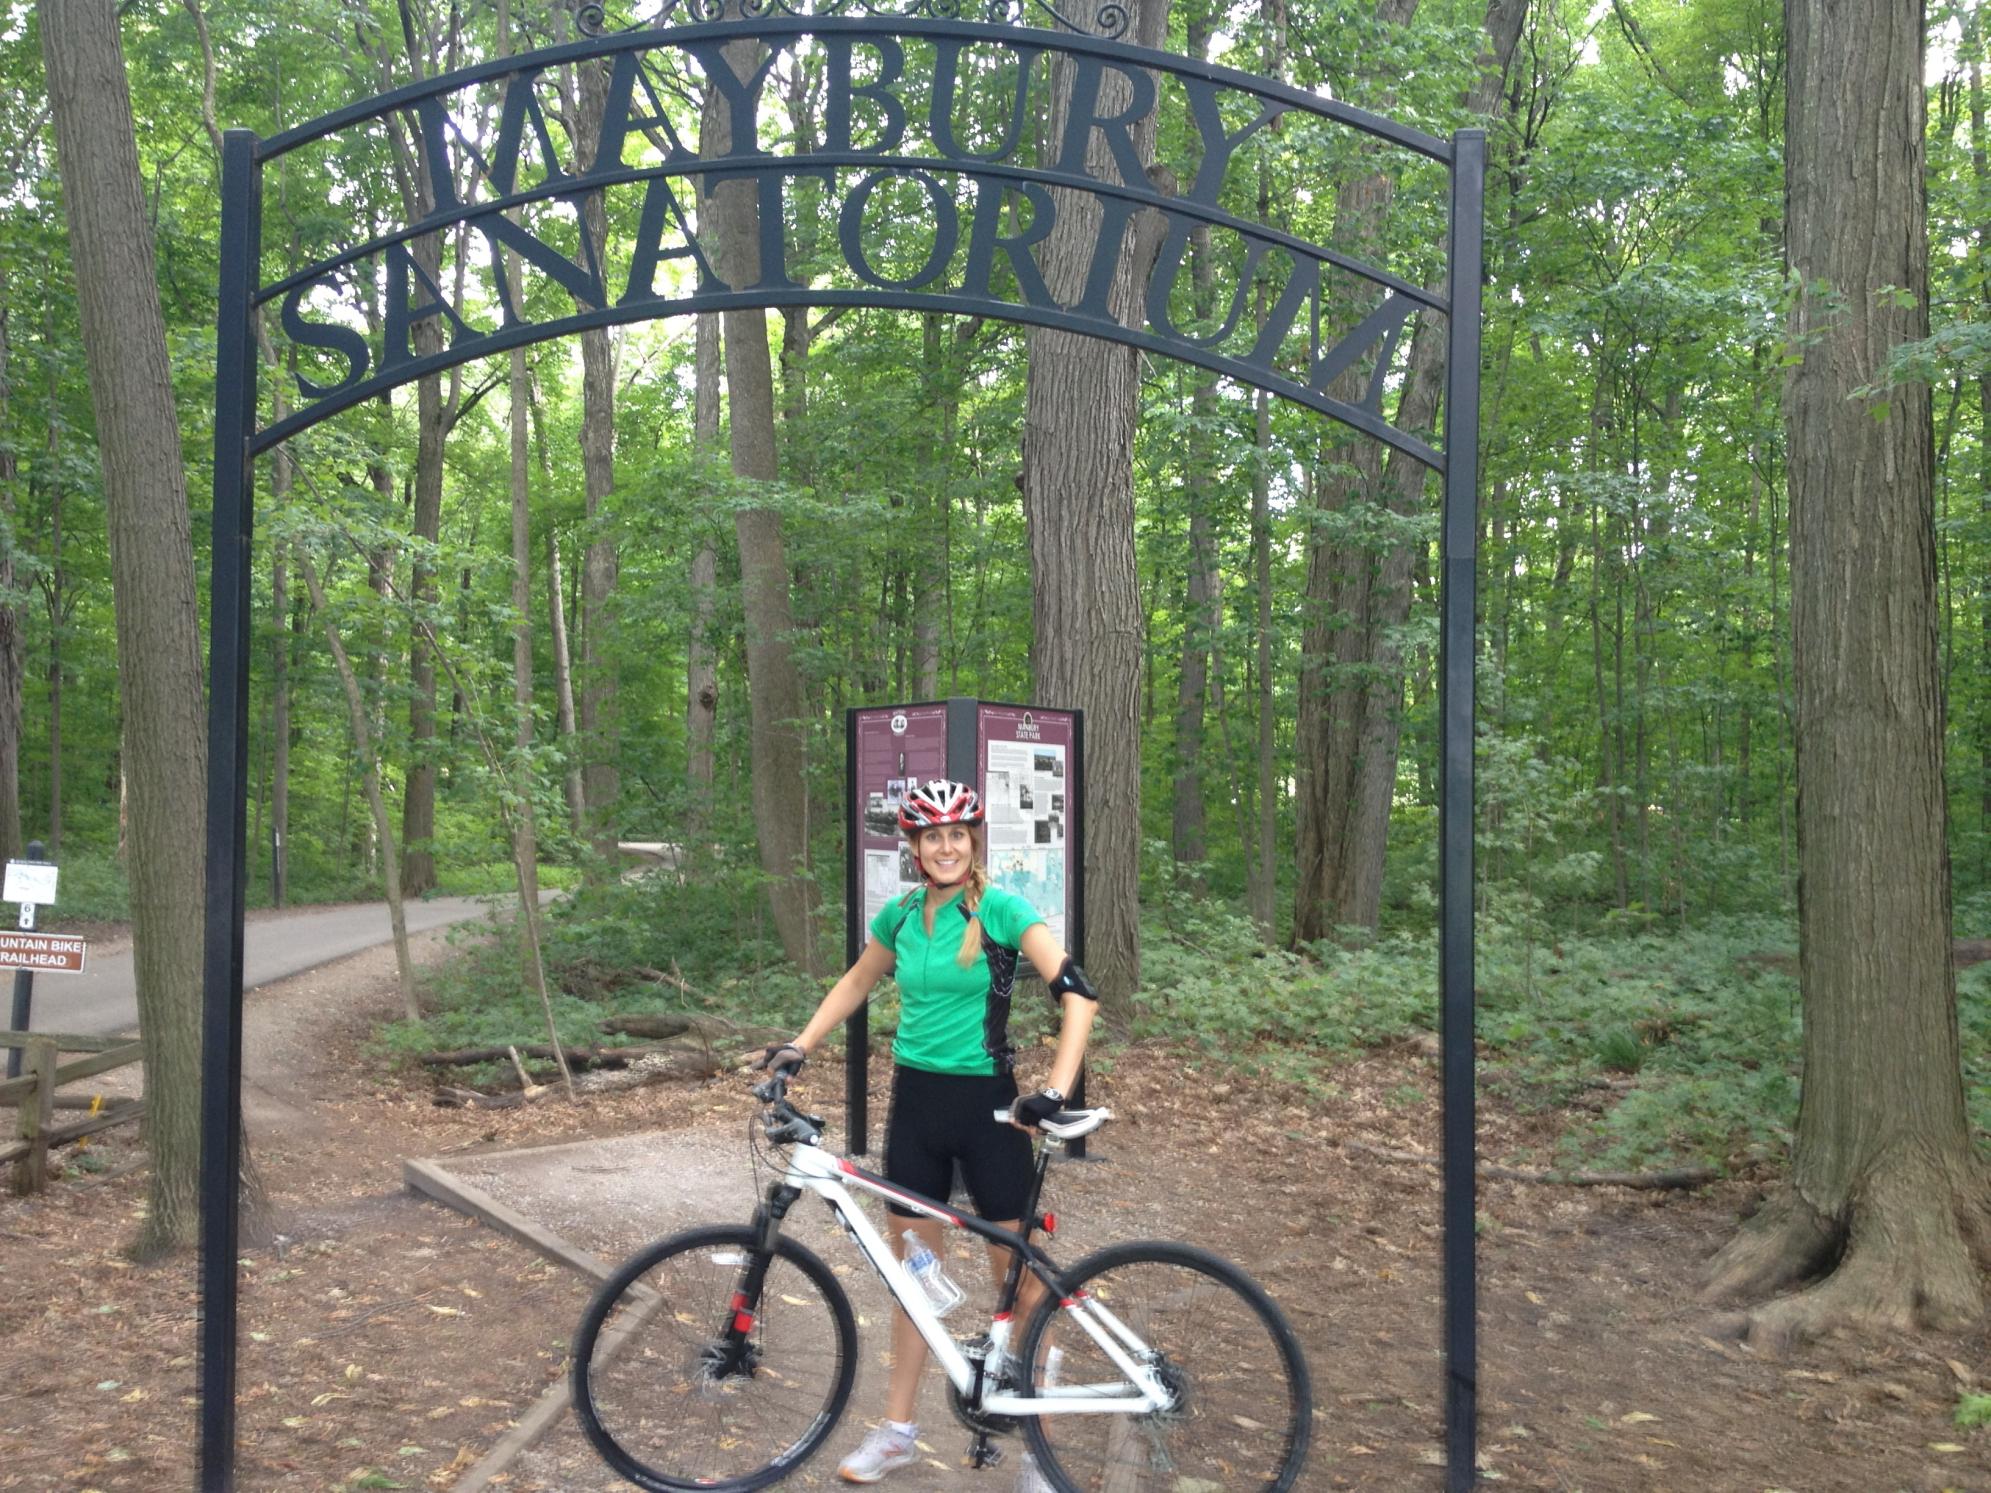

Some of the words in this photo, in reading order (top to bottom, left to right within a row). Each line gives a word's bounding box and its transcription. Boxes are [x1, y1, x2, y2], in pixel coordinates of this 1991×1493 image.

[402, 33, 1297, 218] MAYBURY
[281, 168, 1423, 421] SANATORIUM
[0, 937, 48, 950] UNTAIN
[51, 940, 81, 953] BIKE
[0, 951, 67, 966] RAILHEAD
